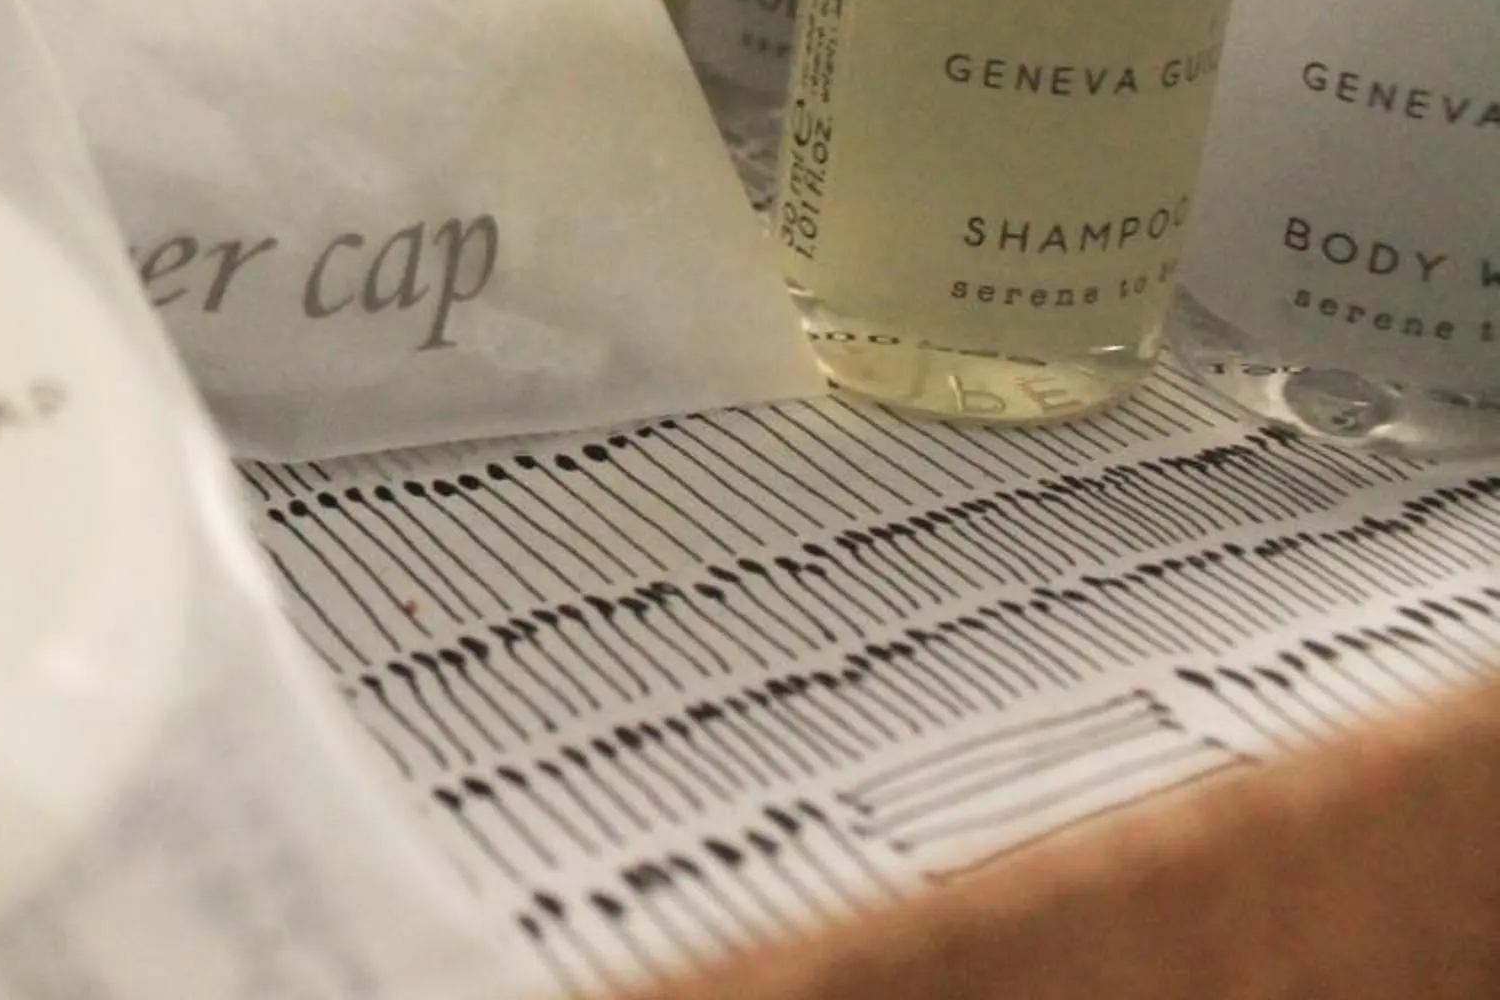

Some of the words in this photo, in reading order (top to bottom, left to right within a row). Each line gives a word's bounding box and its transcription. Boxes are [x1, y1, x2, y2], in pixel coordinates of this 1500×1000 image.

[943, 53, 1139, 95] GENEVA
[1303, 61, 1500, 128] GENEVA
[1284, 216, 1445, 283] BODY
[130, 235, 278, 313] er
[303, 214, 499, 352] cap
[950, 279, 1099, 307] serene
[1294, 289, 1455, 341] serene
